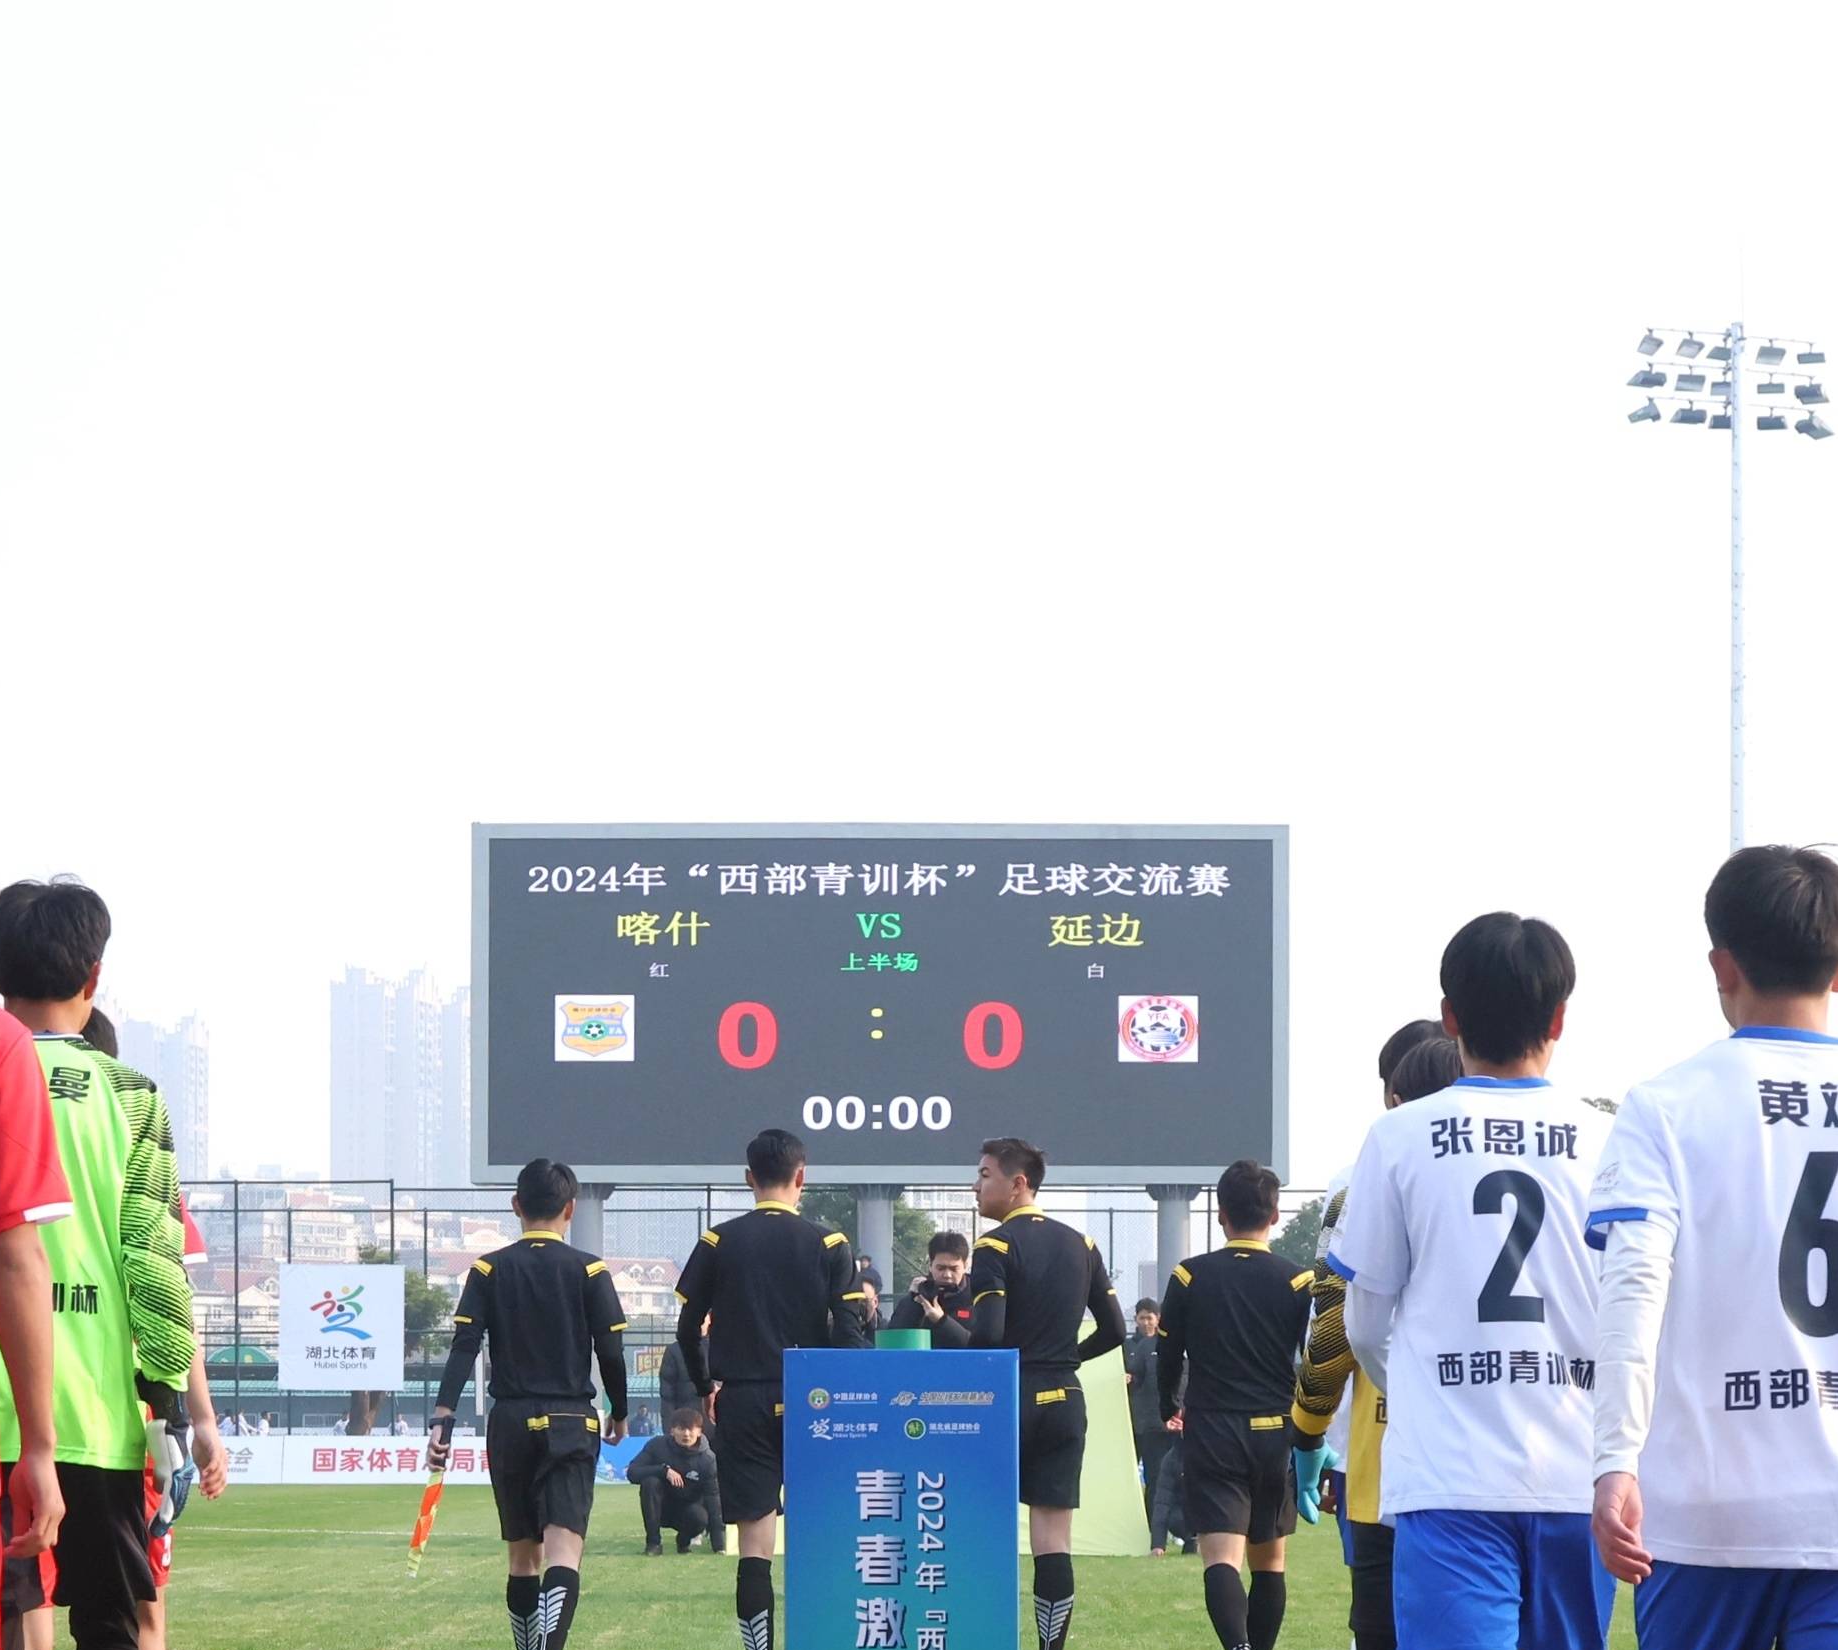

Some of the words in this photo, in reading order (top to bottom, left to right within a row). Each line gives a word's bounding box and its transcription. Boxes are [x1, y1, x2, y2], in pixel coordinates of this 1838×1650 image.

[616, 910, 711, 946] 喀什
[856, 912, 902, 939] VS
[1047, 912, 1144, 948] 延边
[648, 962, 670, 978] 红
[840, 952, 919, 973] 上半场
[1086, 963, 1105, 979] 白
[718, 1001, 778, 1069] 0
[963, 1001, 1023, 1069] 0
[802, 1096, 952, 1130] 00:00
[1431, 1117, 1579, 1161] 张恩诚
[1472, 1169, 1546, 1323] 2
[305, 1345, 378, 1361] 湖北体育
[313, 1360, 338, 1370] Hubei
[339, 1360, 368, 1371] Sports
[1436, 1349, 1596, 1391] 西部青训杯
[832, 1422, 879, 1434] 湖北体育
